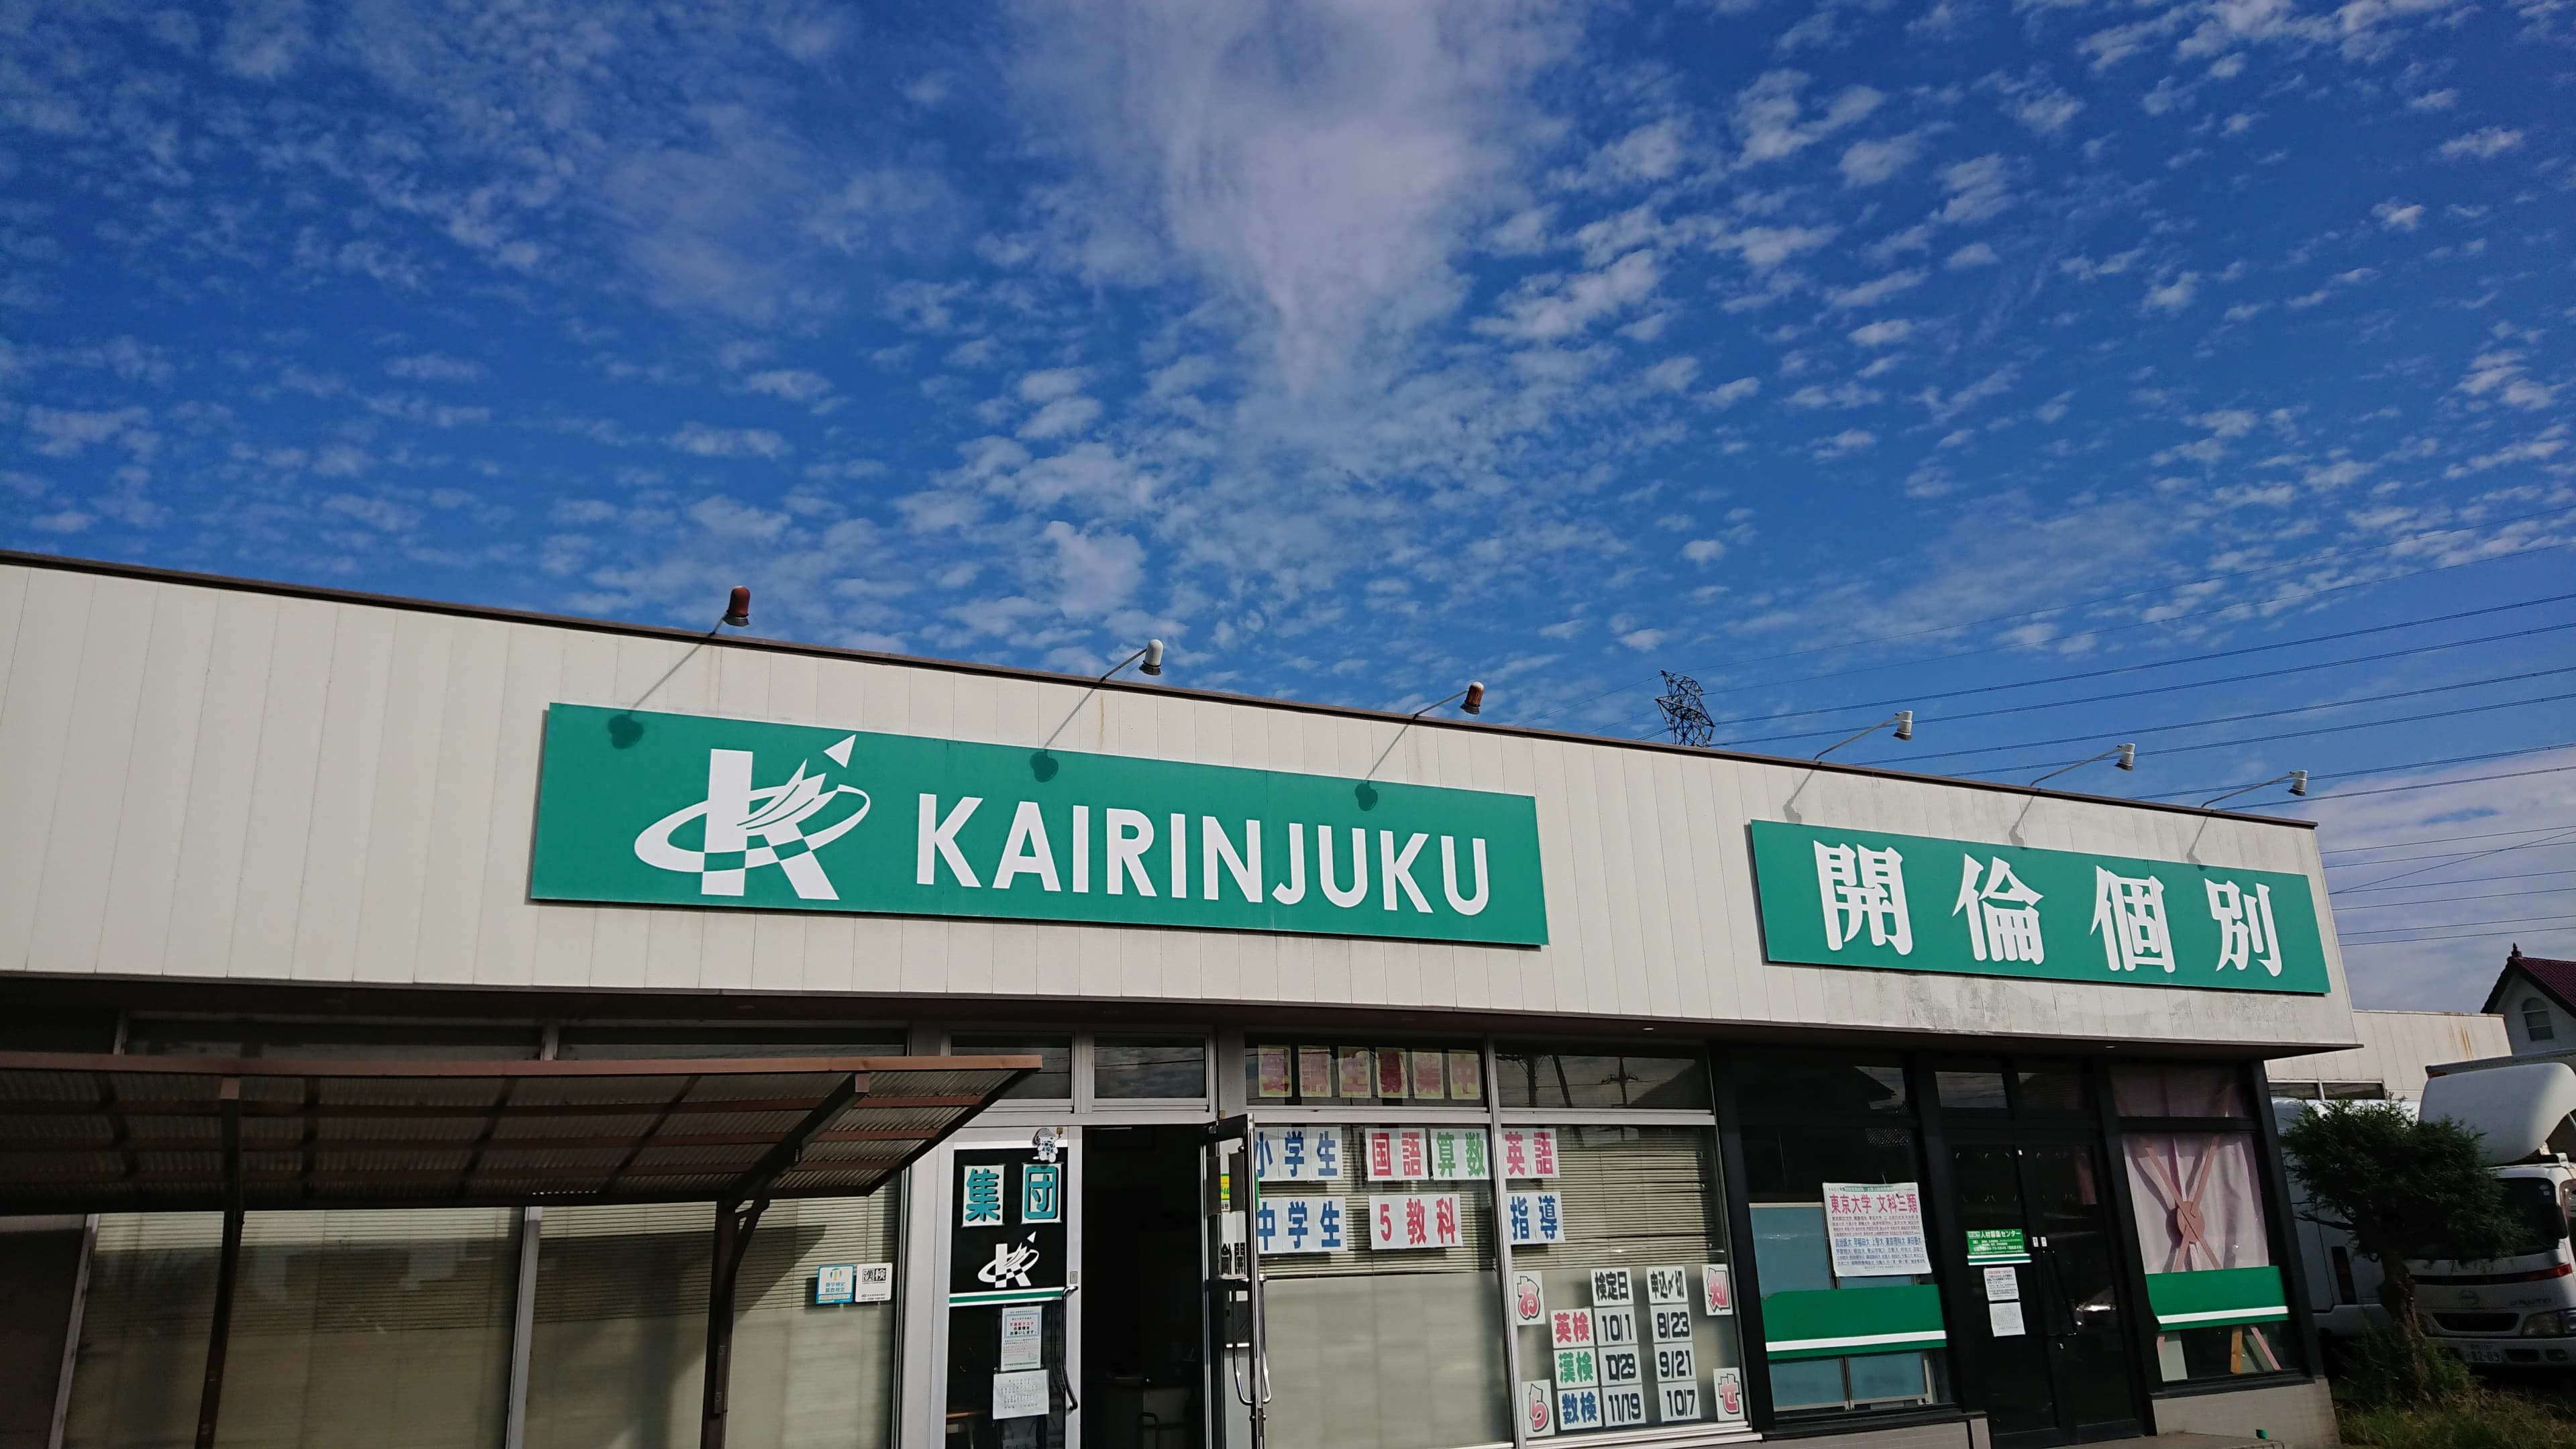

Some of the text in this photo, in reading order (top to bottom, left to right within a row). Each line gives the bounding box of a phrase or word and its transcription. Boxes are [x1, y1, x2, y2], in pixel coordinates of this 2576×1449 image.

[916, 793, 1490, 916] KAIRINJUKU
[1813, 839, 2282, 977] 開倫個別
[1256, 1130, 1338, 1178] 小学生
[1371, 1130, 1554, 1178] 国語 算数 英語
[965, 1165, 1058, 1222] 集団
[1829, 1193, 1919, 1214] 東京大学 文科三類
[1257, 1200, 1342, 1250] 中学生
[1379, 1197, 1456, 1245] 5教科
[1509, 1195, 1558, 1241] 指導
[862, 1268, 886, 1282] 漢検
[1594, 1271, 1630, 1301] 検定日
[1554, 1311, 1690, 1343] 英検 10/1 8/23
[1558, 1350, 1693, 1384] 漢検 10/29 9/21
[1561, 1389, 1696, 1425] 数検 11/19 10/7
